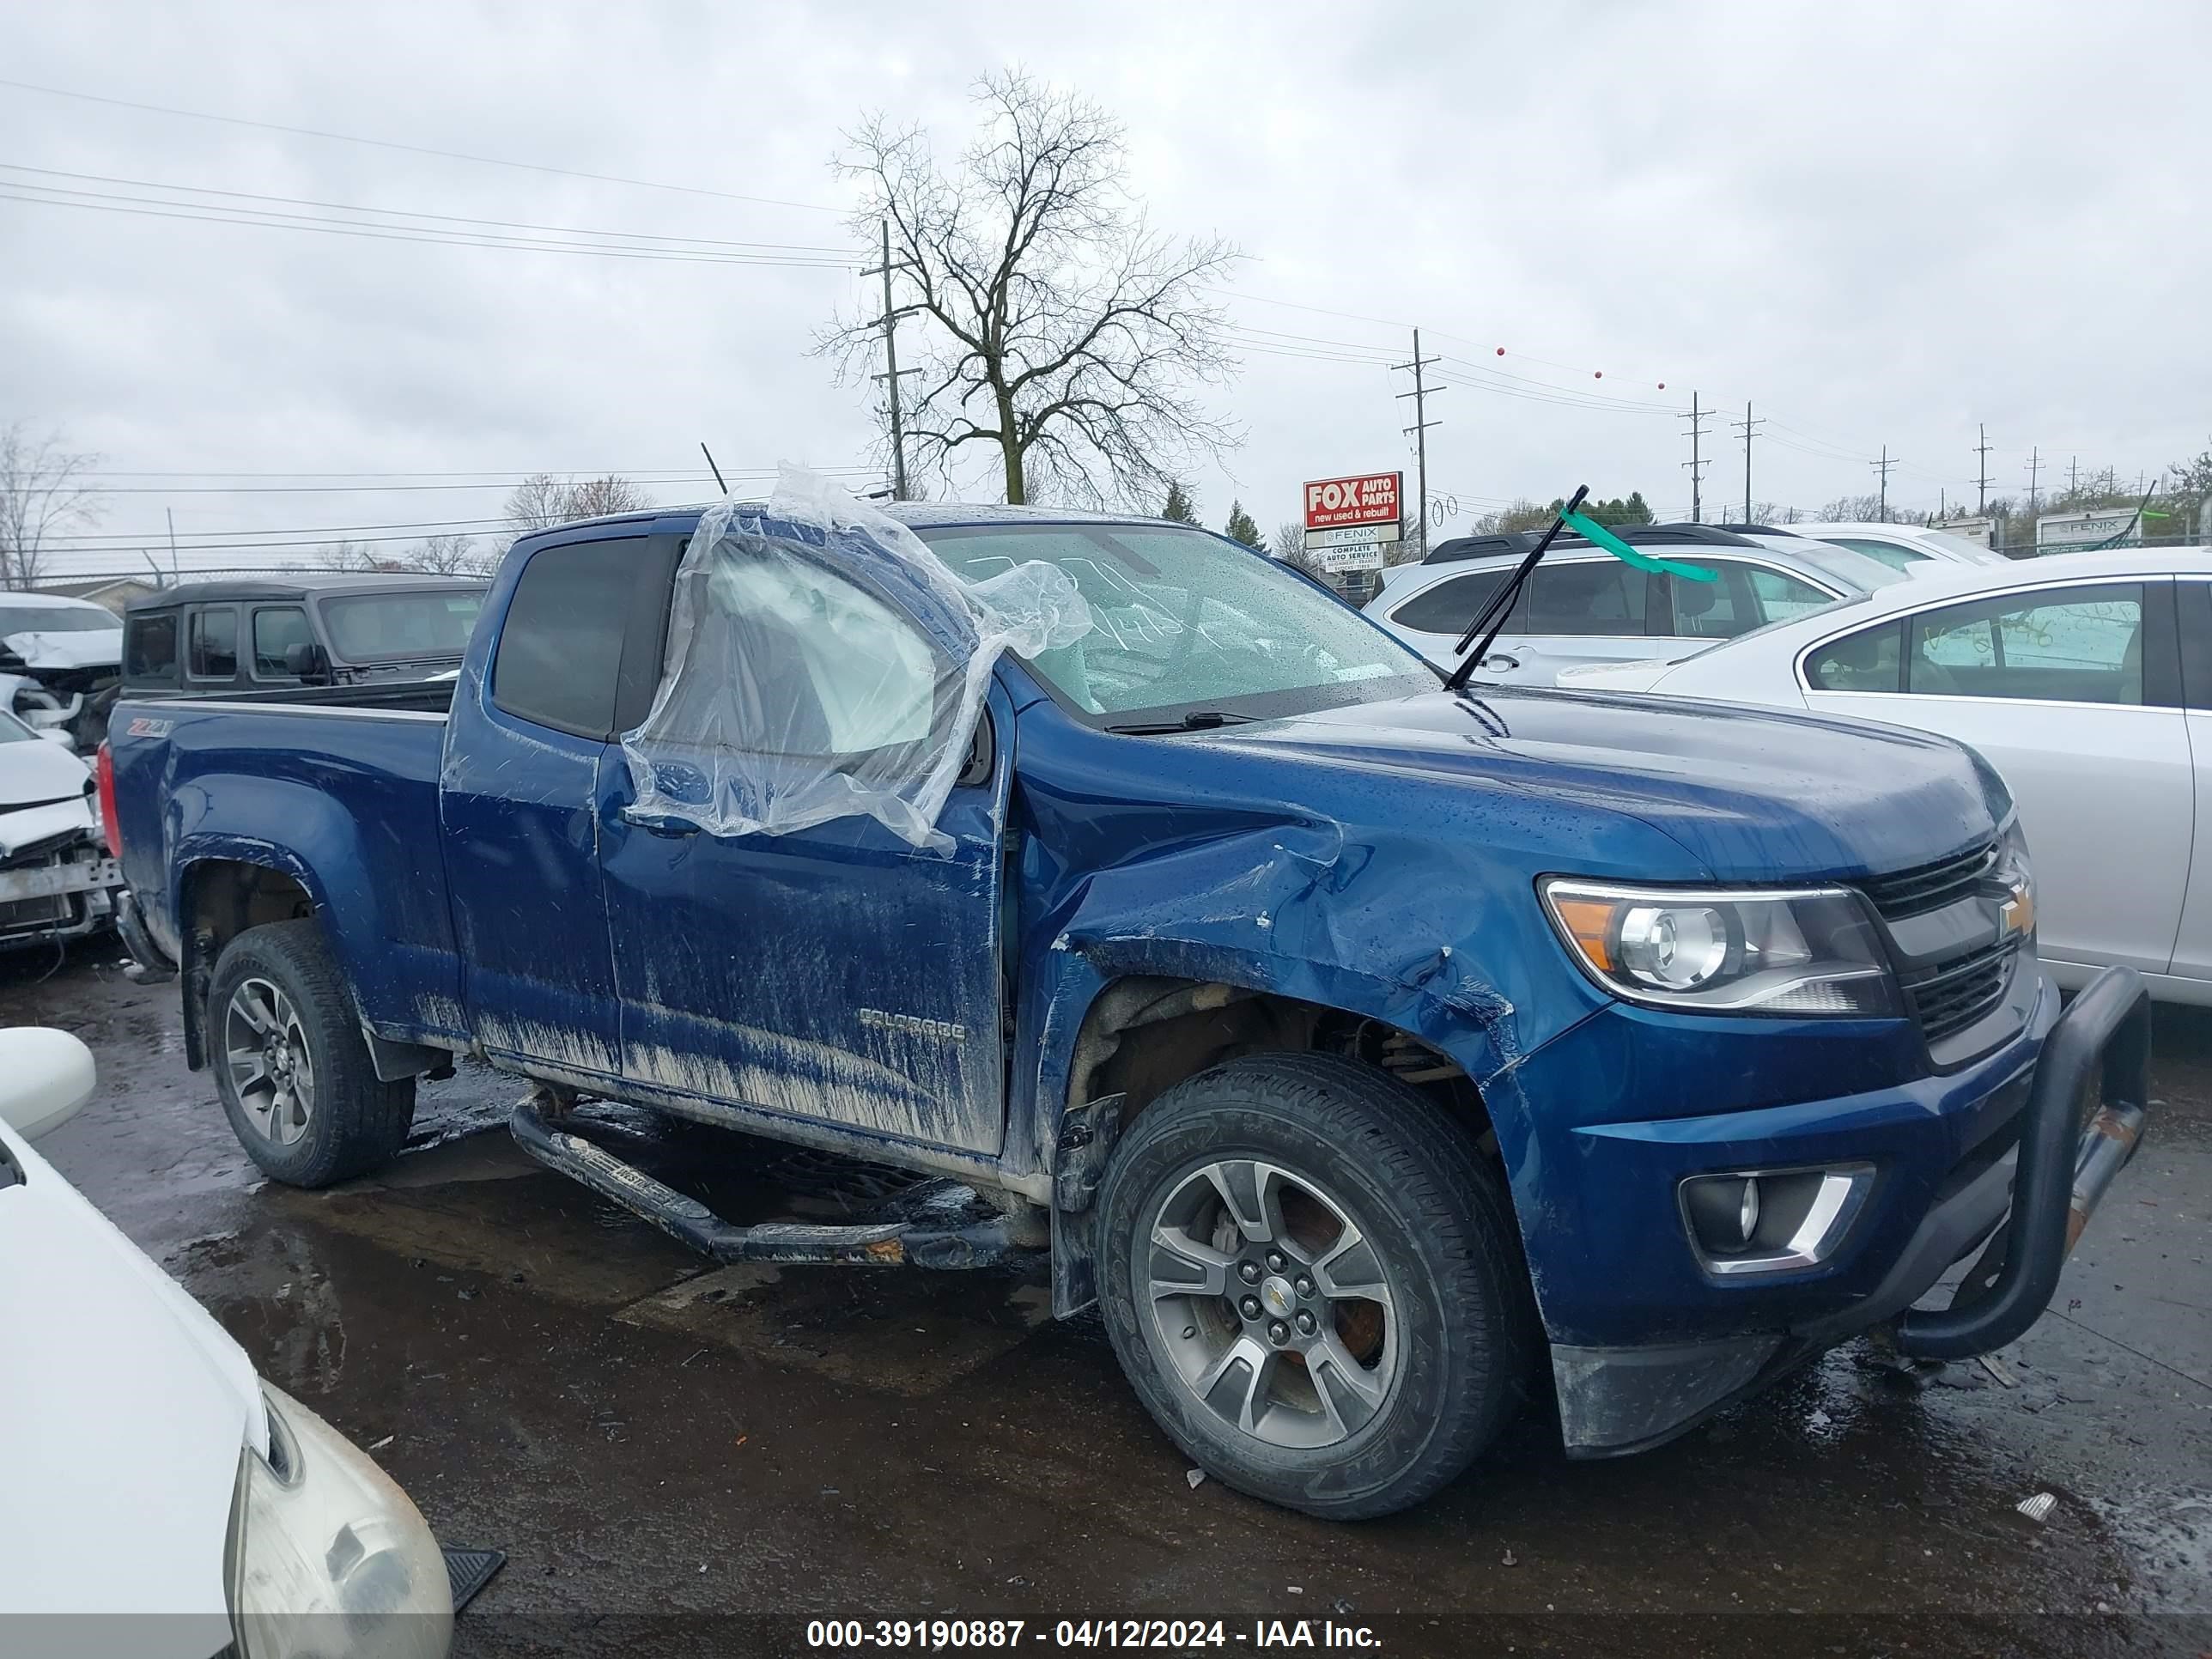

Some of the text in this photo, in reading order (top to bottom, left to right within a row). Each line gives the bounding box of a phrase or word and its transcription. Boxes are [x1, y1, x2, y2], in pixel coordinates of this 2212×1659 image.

[1362, 478, 1391, 492] AUTO
[1309, 482, 1360, 511] FOX
[1362, 491, 1395, 506] PARTS
[1315, 507, 1389, 523] new used & rebuilt
[1335, 528, 1376, 539] FENIX
[2070, 521, 2118, 532] FENIX
[1333, 545, 1371, 554] COMPLETE
